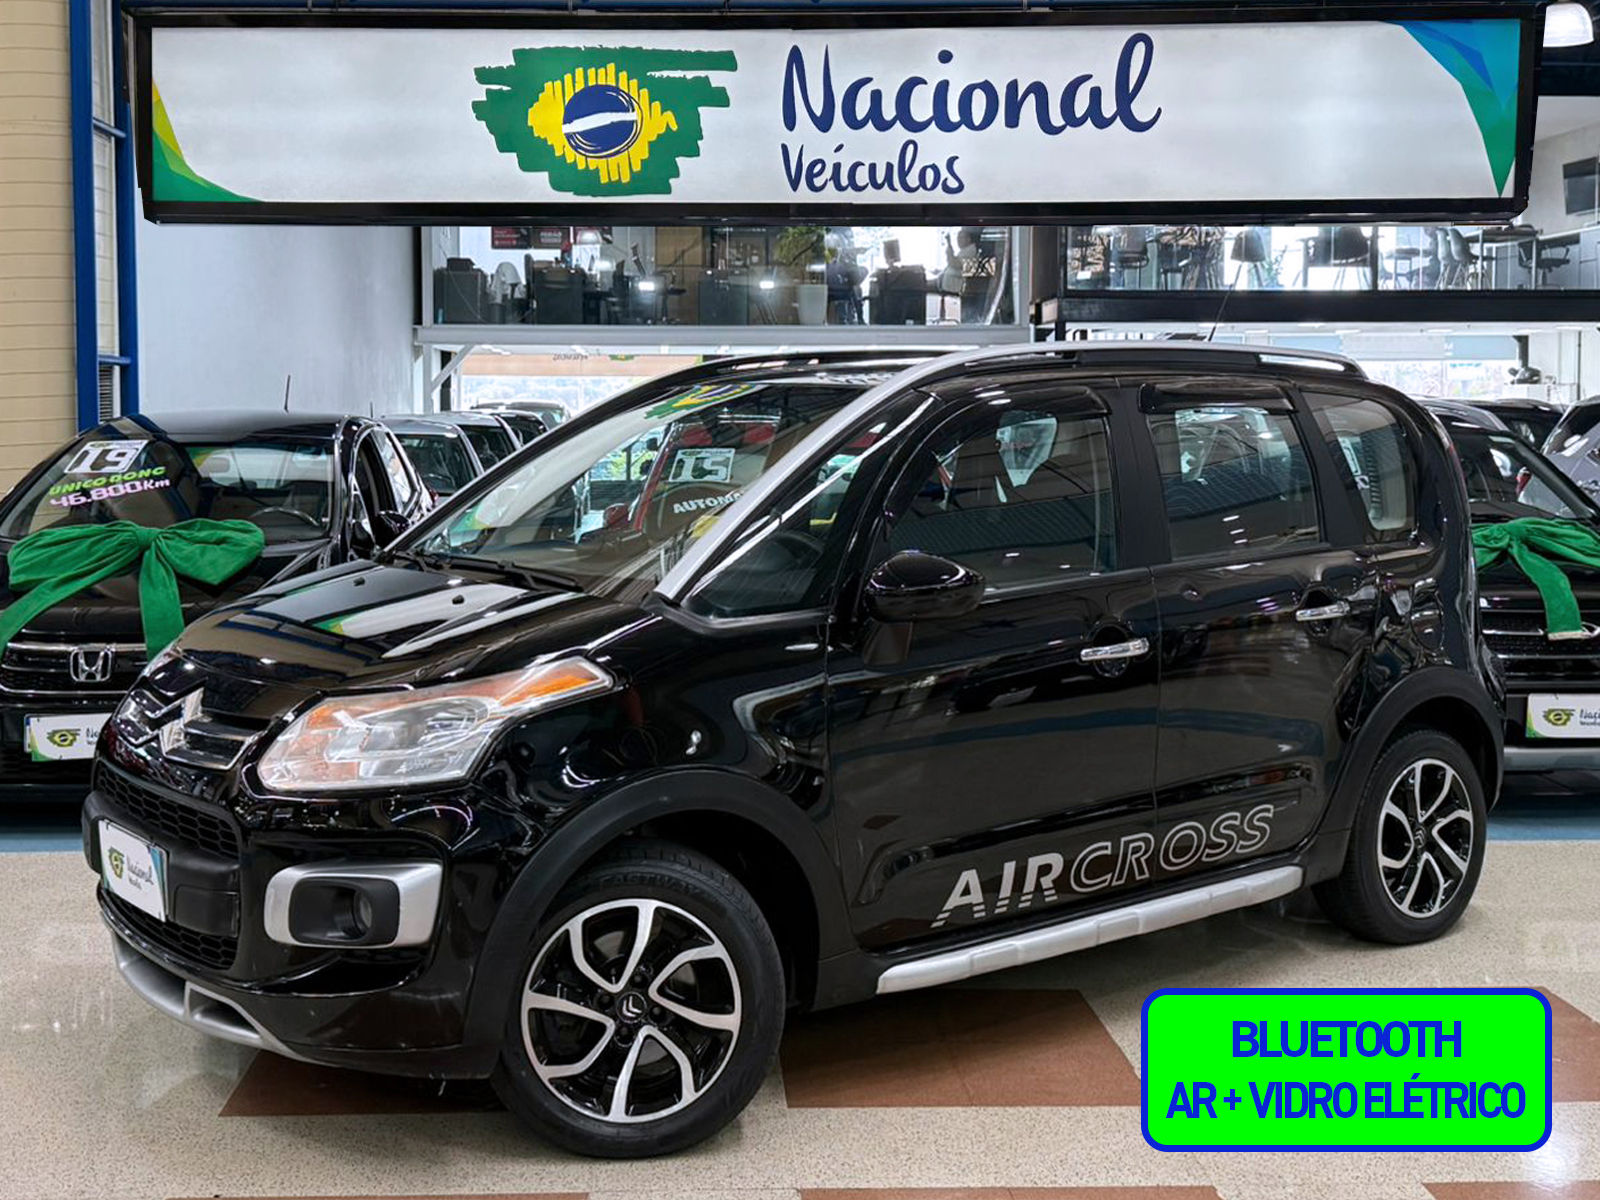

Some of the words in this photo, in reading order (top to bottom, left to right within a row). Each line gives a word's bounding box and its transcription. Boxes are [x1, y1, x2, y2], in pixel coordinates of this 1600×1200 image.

[781, 32, 1162, 134] Nacional
[781, 139, 965, 196] Veículos
[71, 448, 138, 473] 19
[675, 456, 728, 480] 15
